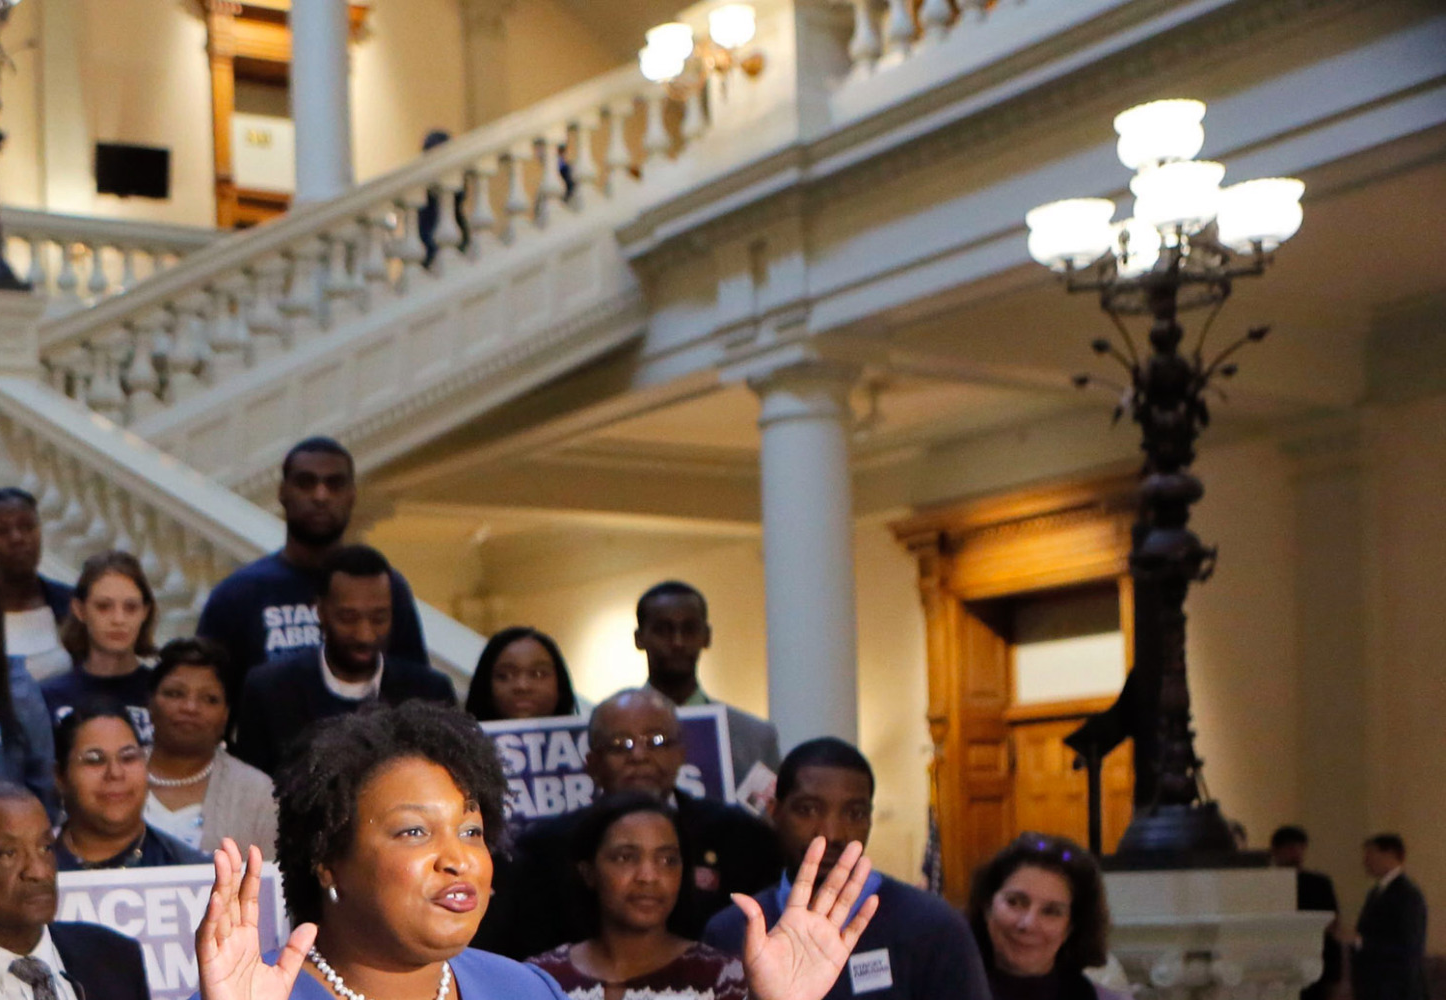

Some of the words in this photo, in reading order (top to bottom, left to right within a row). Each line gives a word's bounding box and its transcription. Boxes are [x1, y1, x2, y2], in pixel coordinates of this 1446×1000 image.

[263, 603, 320, 627] STA
[266, 625, 321, 651] ABR
[497, 730, 590, 777] STA
[60, 886, 212, 938] ACEY
